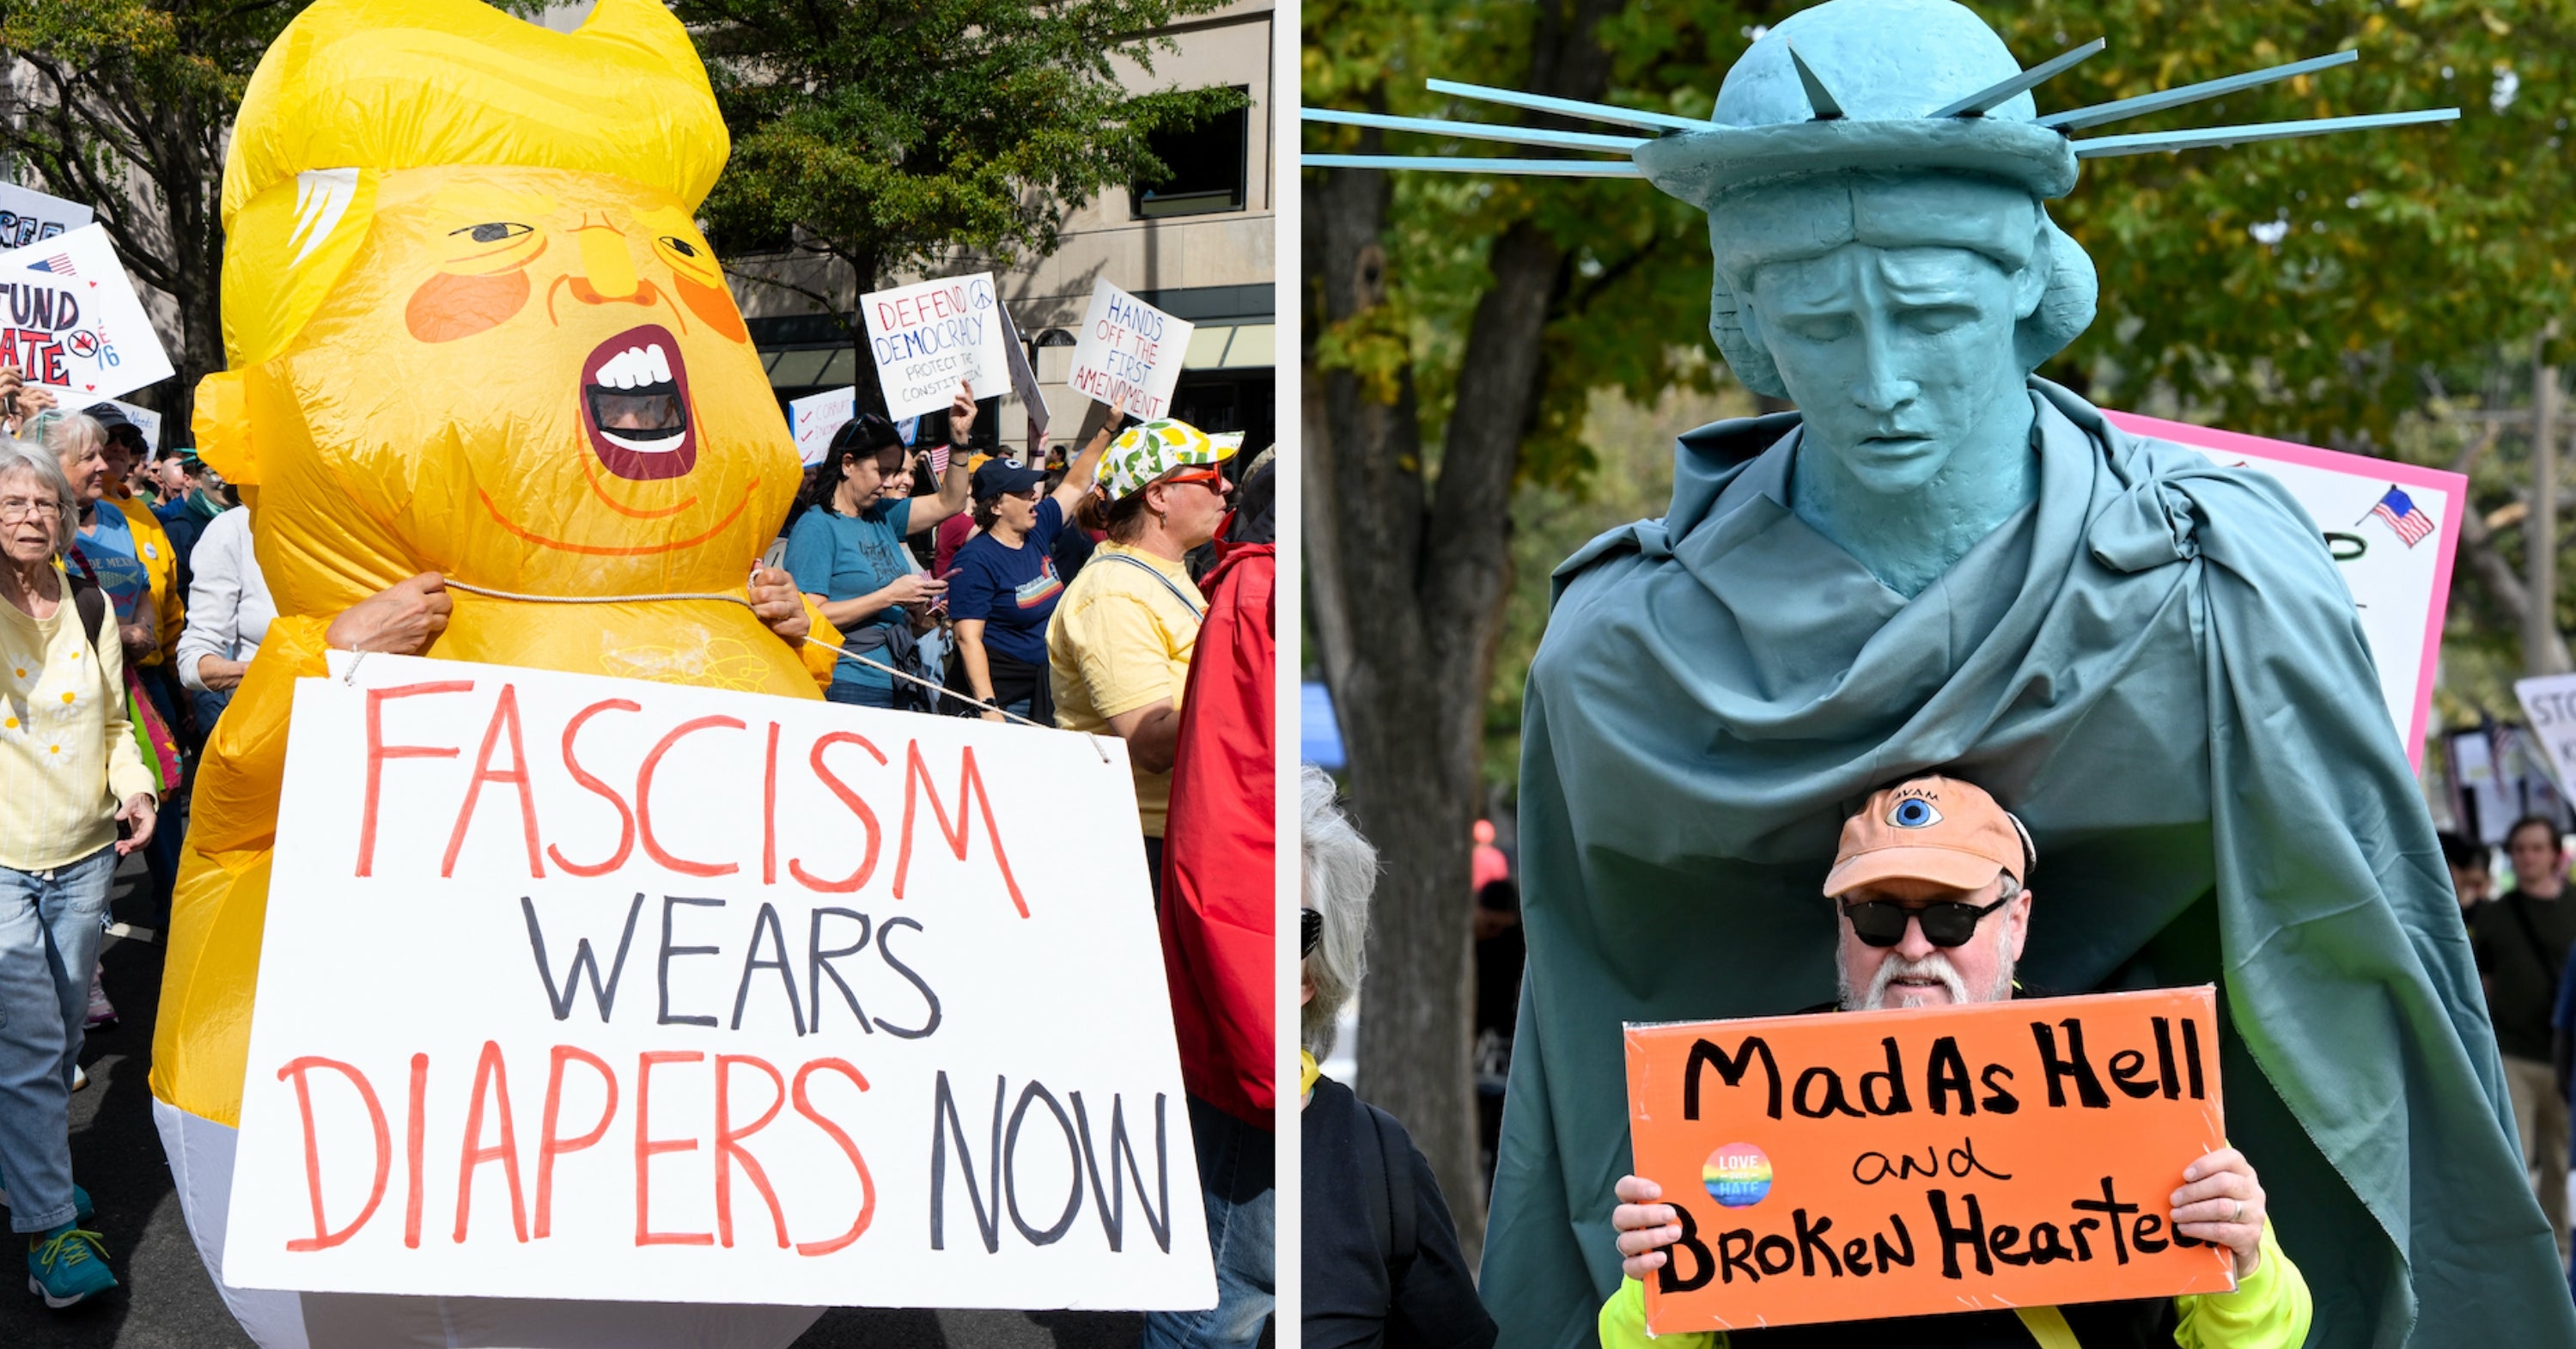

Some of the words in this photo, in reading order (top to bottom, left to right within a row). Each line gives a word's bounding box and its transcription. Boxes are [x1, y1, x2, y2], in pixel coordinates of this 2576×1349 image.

[877, 285, 967, 332] DEFEND
[1107, 293, 1164, 342] HANDS
[874, 312, 984, 365] DEMOCRACY
[1096, 319, 1125, 347] OFF
[1135, 334, 1158, 366] THE
[905, 355, 958, 382] PROTECT
[1106, 349, 1152, 386] FIRST
[356, 681, 1030, 919] FASCISM
[521, 893, 942, 1040] WEARS
[1684, 1035, 1912, 1120] Mad
[1927, 1035, 2020, 1117] As
[2031, 1016, 2205, 1108] Hell
[277, 1041, 876, 1256] DIAPERS
[930, 1070, 1171, 1254] NOW
[1719, 1155, 1759, 1170] LOVE
[1720, 1181, 1759, 1196] HATE
